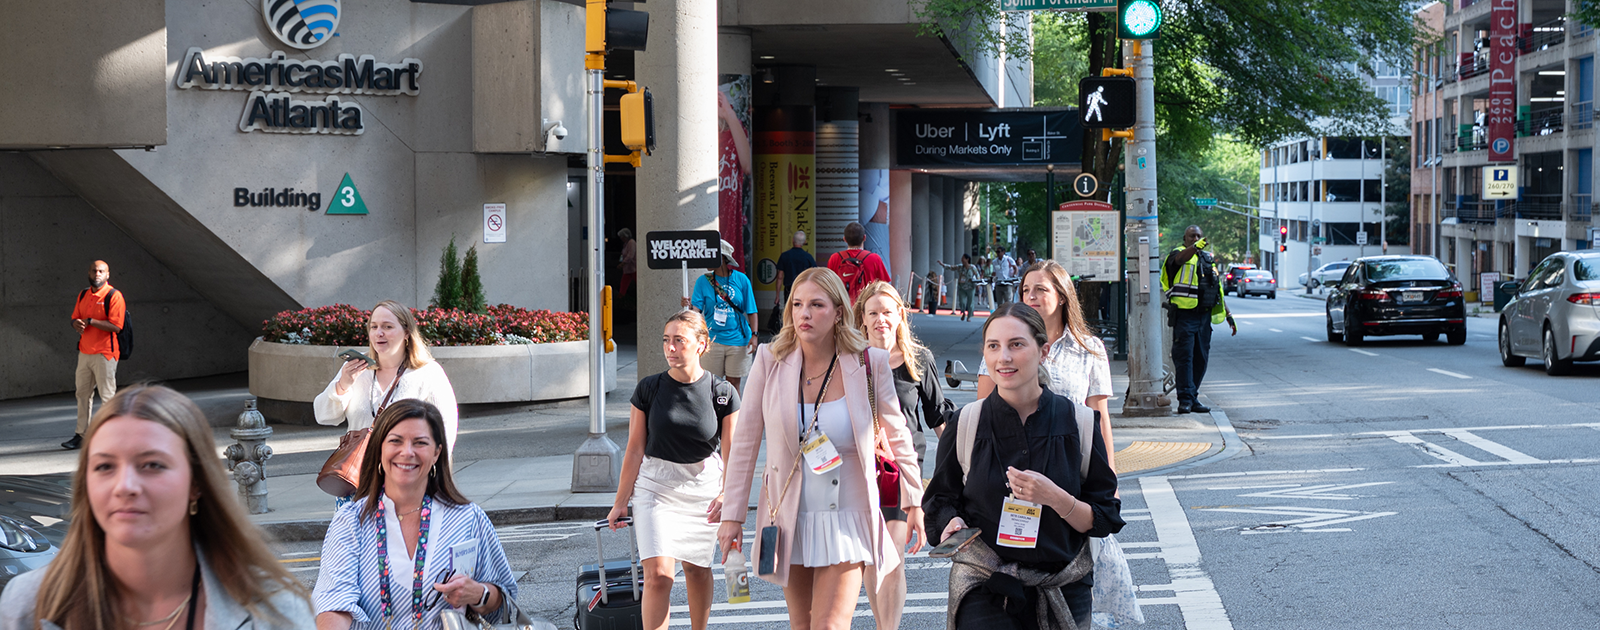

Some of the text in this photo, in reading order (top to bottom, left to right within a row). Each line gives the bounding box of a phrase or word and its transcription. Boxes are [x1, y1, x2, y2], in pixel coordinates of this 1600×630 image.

[186, 51, 419, 91] AmericasMart
[248, 96, 363, 129] Atlanta
[1491, 98, 1501, 124] 260
[1502, 98, 1513, 124] 270
[915, 123, 955, 138] Uber
[979, 123, 1011, 141] Lyft
[915, 144, 1012, 156] During Markets Only
[1497, 140, 1507, 152] P
[1498, 170, 1505, 180] P
[233, 186, 355, 211] Building 3
[767, 161, 778, 247] Beeswax Lip Balm
[794, 195, 808, 247] Nak
[650, 239, 707, 250] WELCOME
[650, 248, 718, 260] TO MARKET
[737, 573, 748, 586] G
